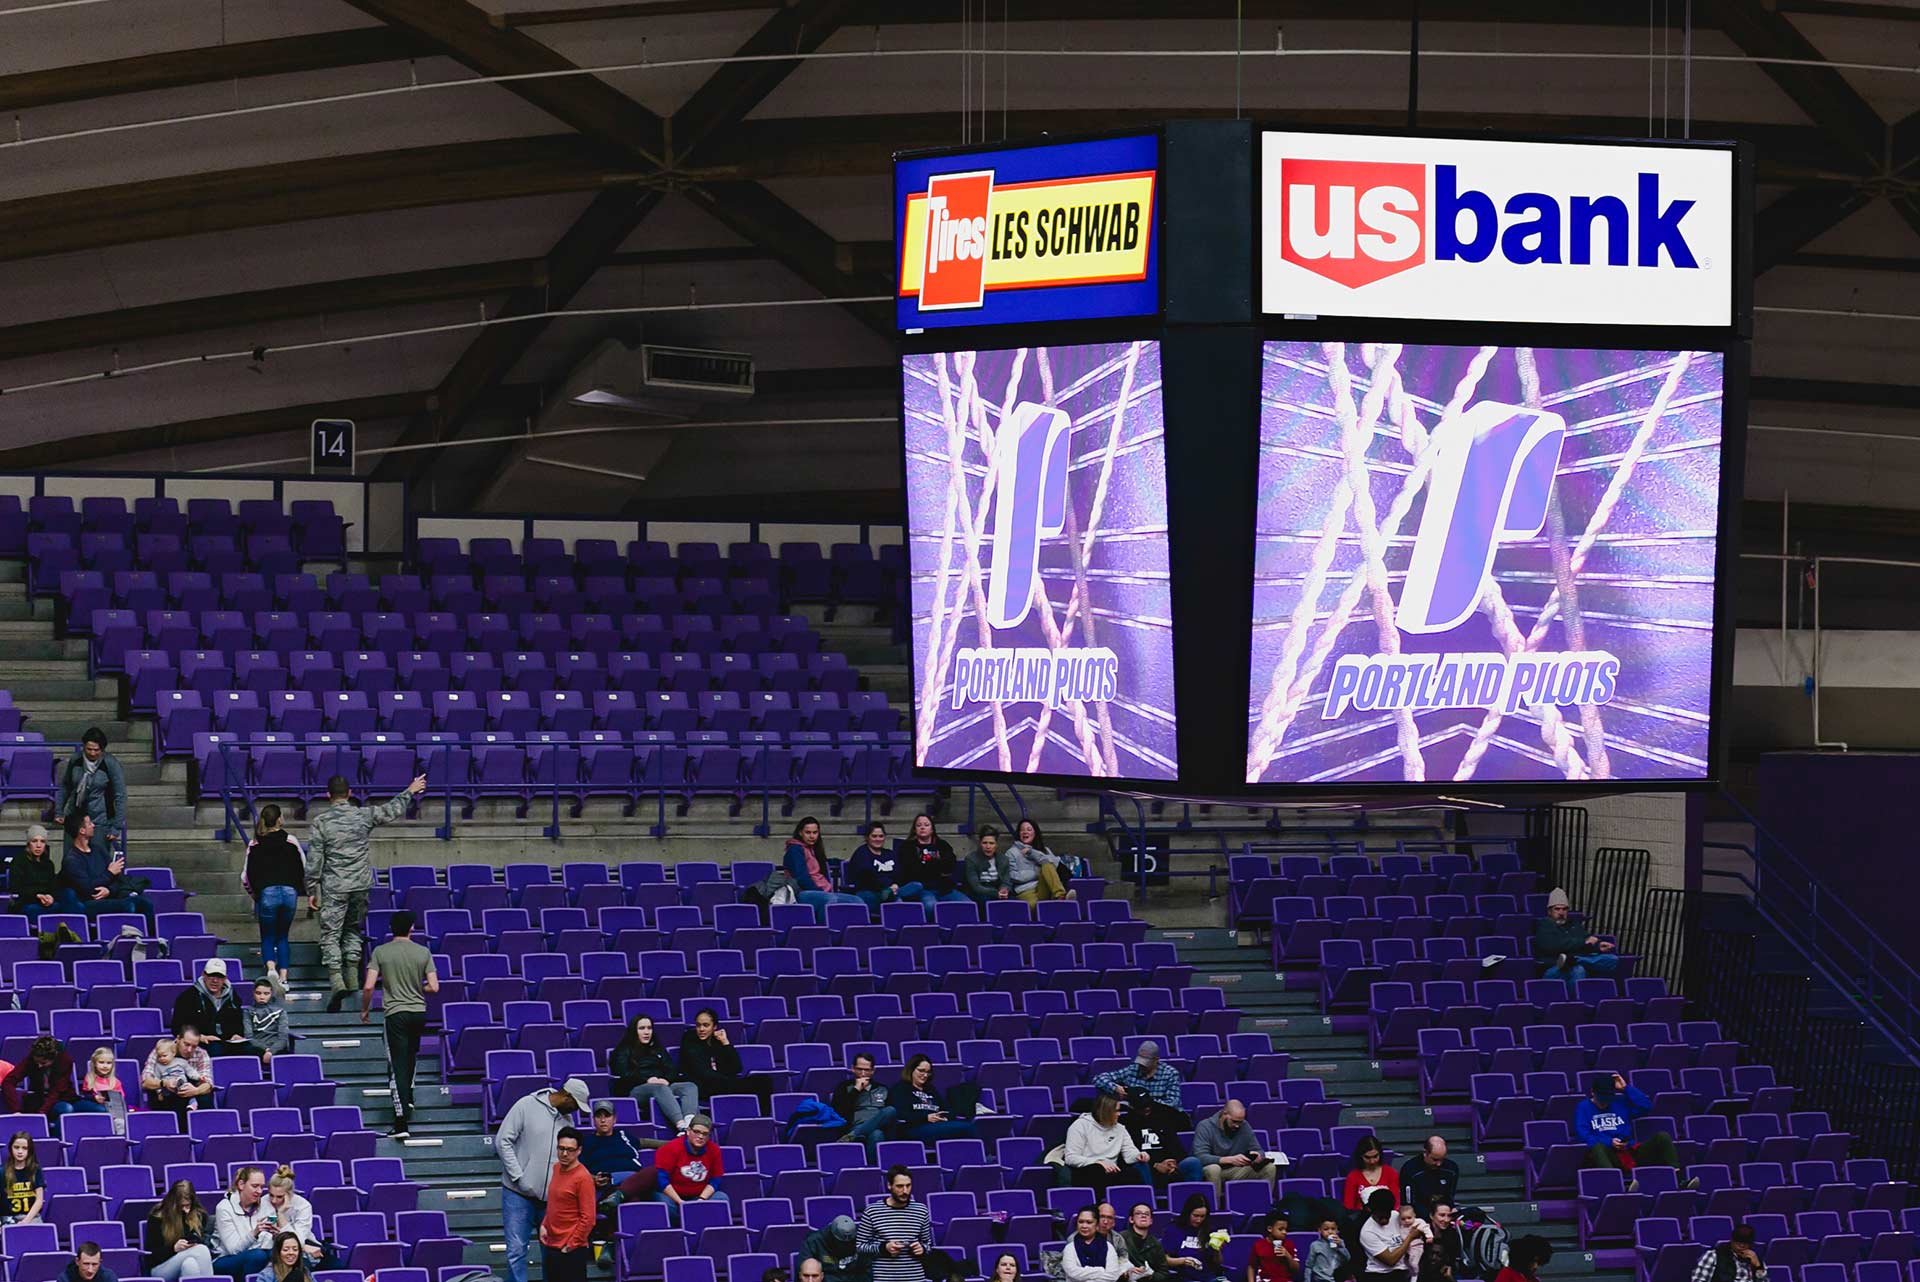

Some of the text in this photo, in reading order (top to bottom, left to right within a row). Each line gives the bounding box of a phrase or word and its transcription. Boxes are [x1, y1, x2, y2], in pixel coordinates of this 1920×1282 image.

[929, 196, 986, 274] Tires
[991, 202, 1140, 261] LES SCHWAB
[318, 430, 346, 457] 14
[953, 652, 1117, 709] PORTLAND PILOTS
[1322, 655, 1619, 718] PORTLAND PILOTS
[1130, 846, 1157, 873] 15
[1423, 1108, 1432, 1116] 13
[483, 1137, 492, 1145] 13
[1476, 1155, 1485, 1163] 12
[11, 1197, 30, 1213] 31
[1530, 1204, 1538, 1212] 11
[1584, 1253, 1593, 1261] 10
